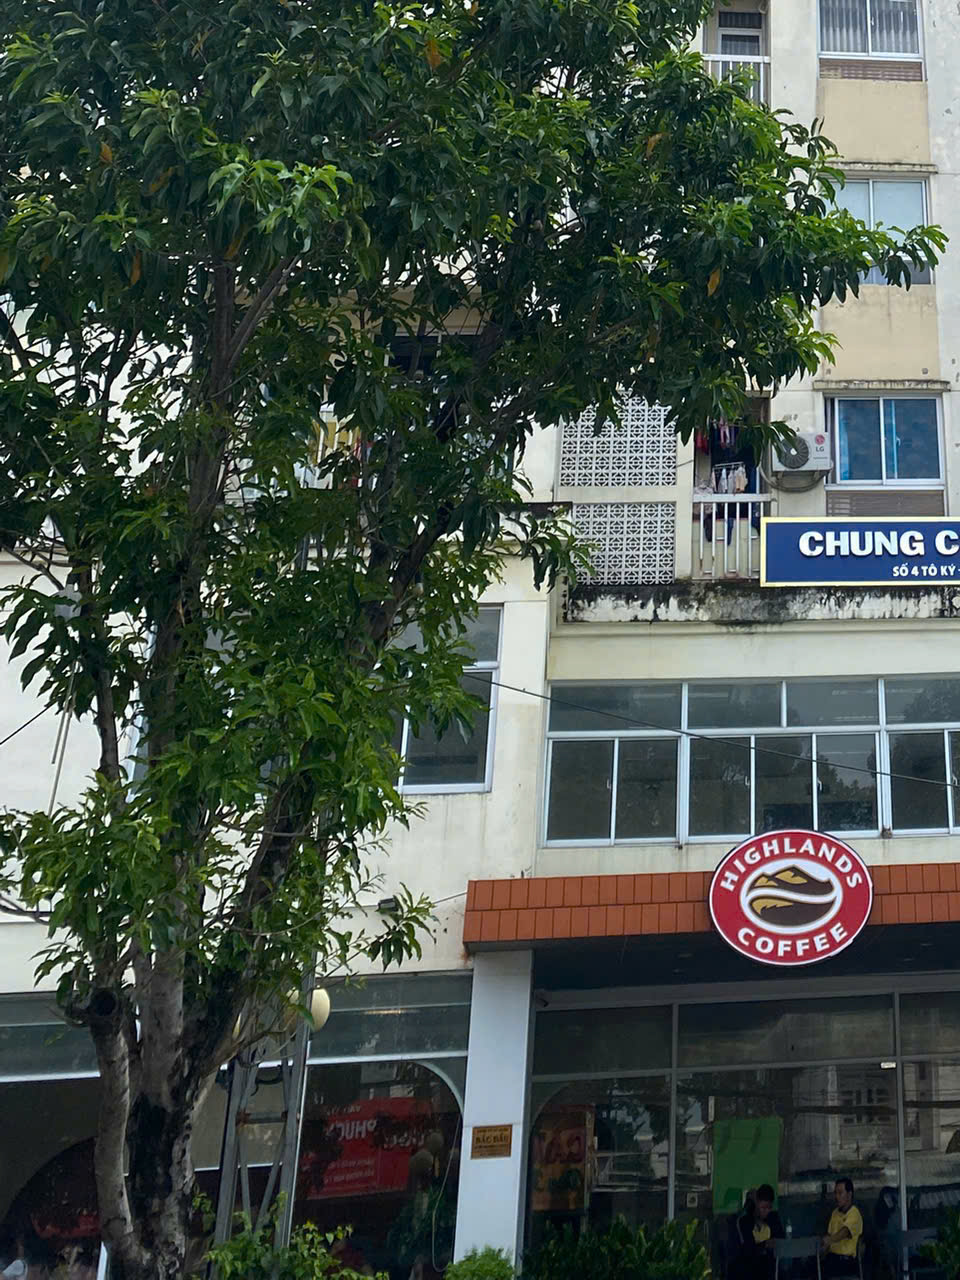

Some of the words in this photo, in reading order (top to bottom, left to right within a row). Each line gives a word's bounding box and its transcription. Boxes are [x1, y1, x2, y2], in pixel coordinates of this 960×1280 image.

[799, 530, 925, 556] CHUNG
[892, 563, 909, 576] SỐ
[911, 566, 920, 576] 4
[921, 563, 938, 576] TÔ
[940, 563, 956, 576] KÝ
[720, 837, 863, 892] HIGHLANDS
[737, 923, 848, 957] COFFEE
